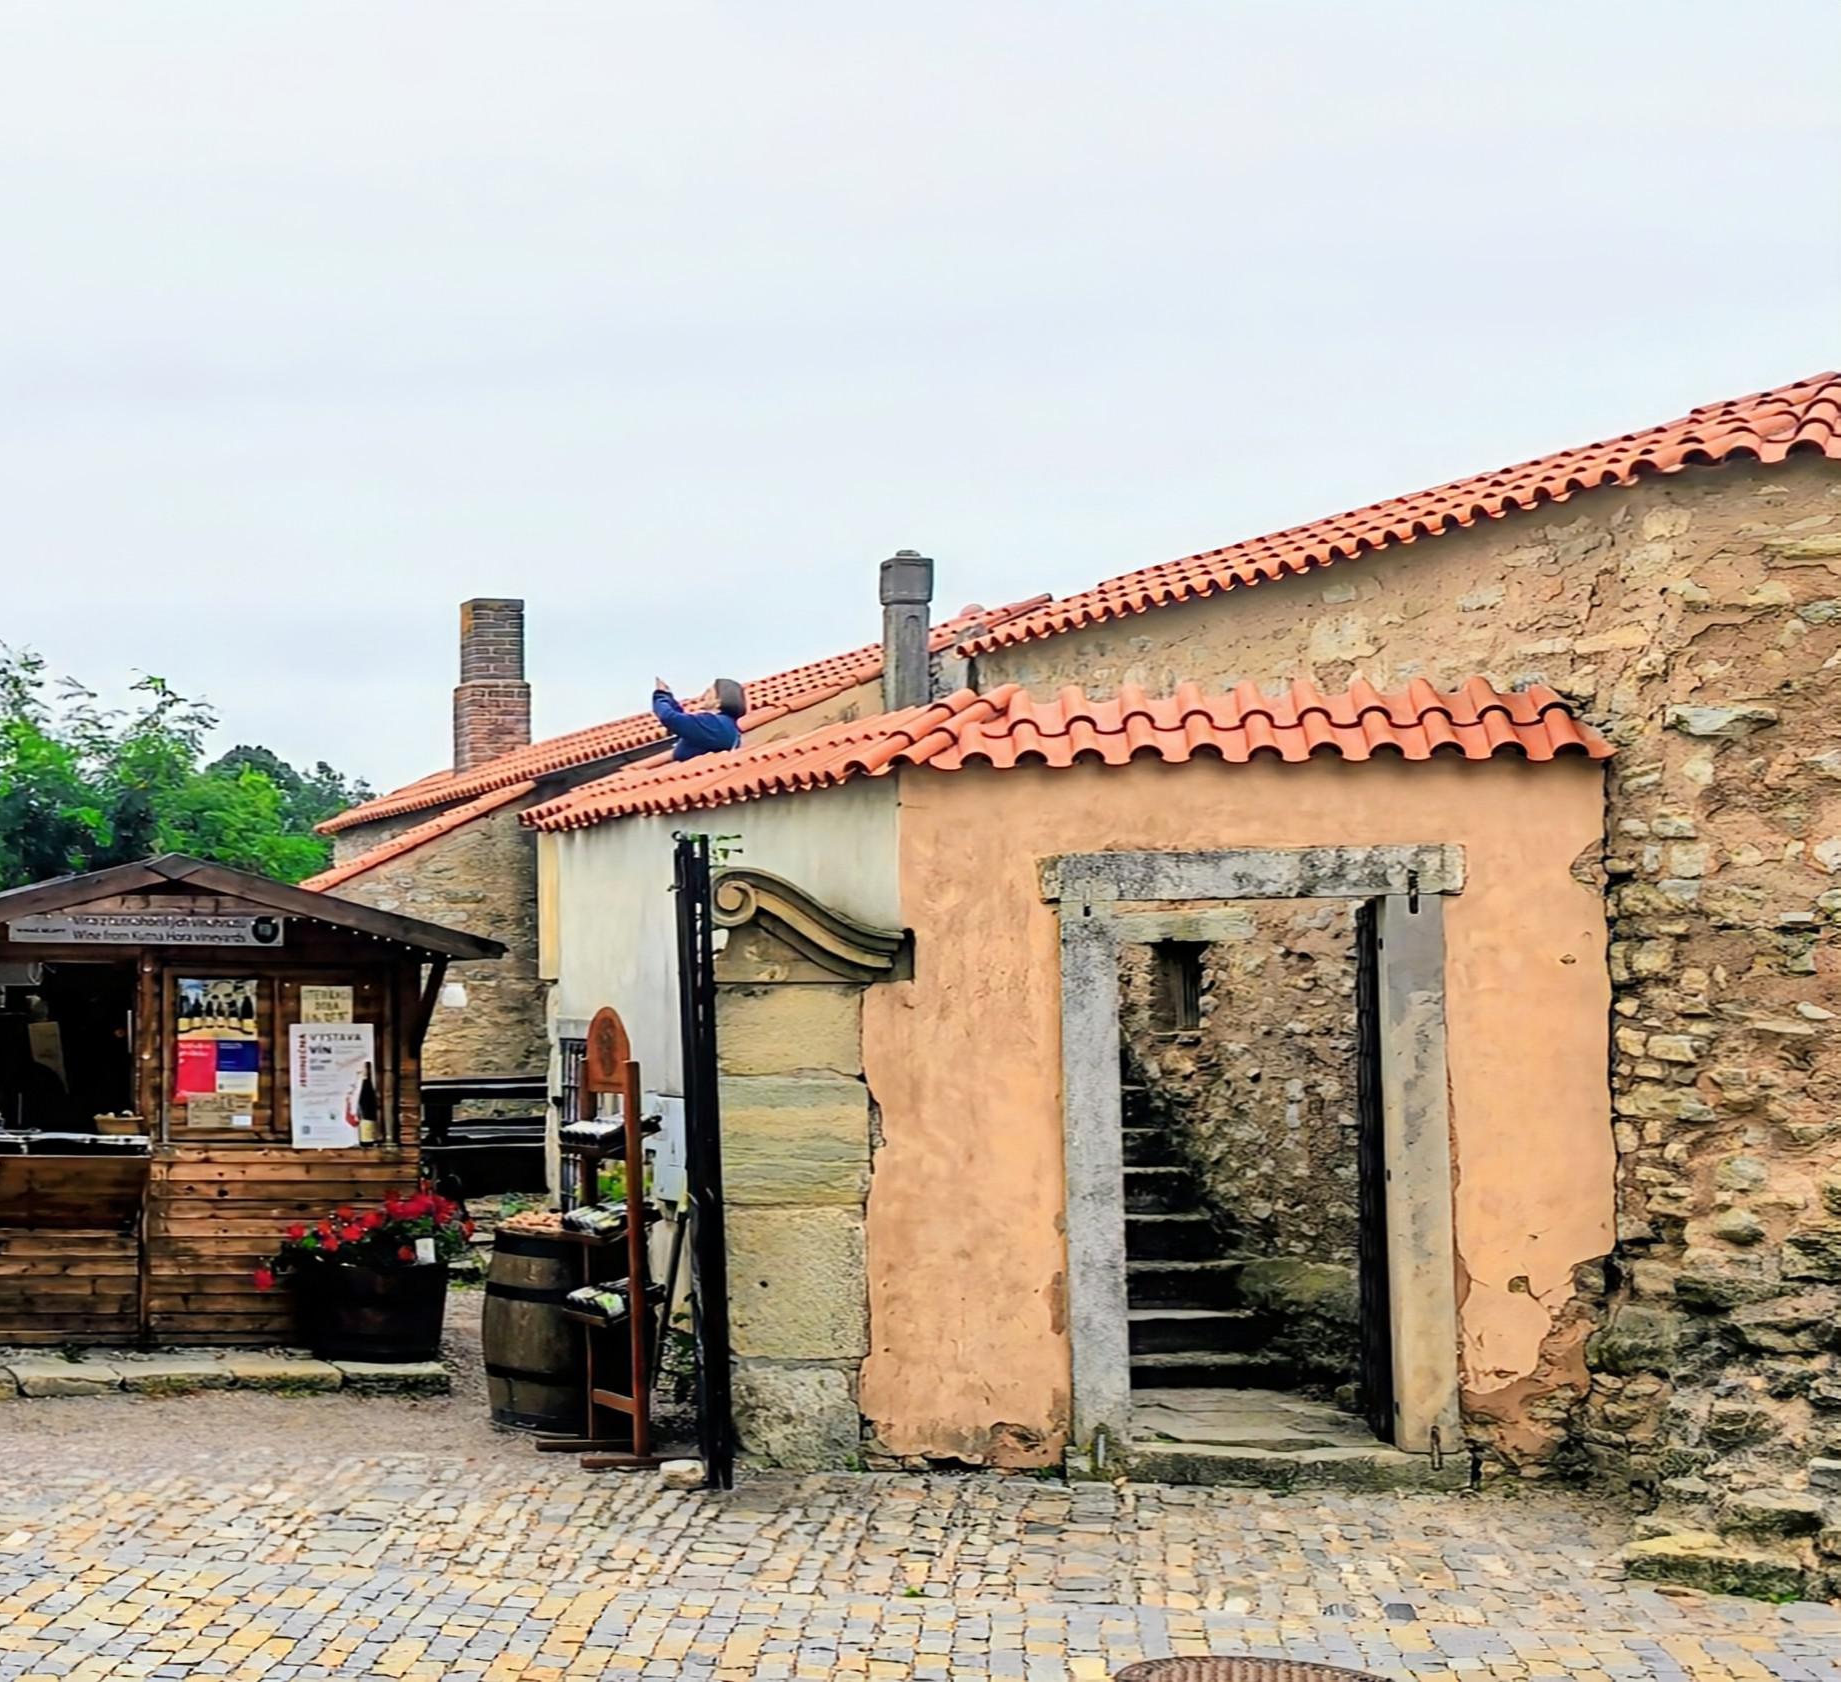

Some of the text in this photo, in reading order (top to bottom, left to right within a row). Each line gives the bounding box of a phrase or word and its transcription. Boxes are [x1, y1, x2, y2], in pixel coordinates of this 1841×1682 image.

[73, 930, 101, 940] Wine
[103, 930, 130, 940] from
[166, 932, 192, 942] Hora
[194, 932, 247, 944] vineyards
